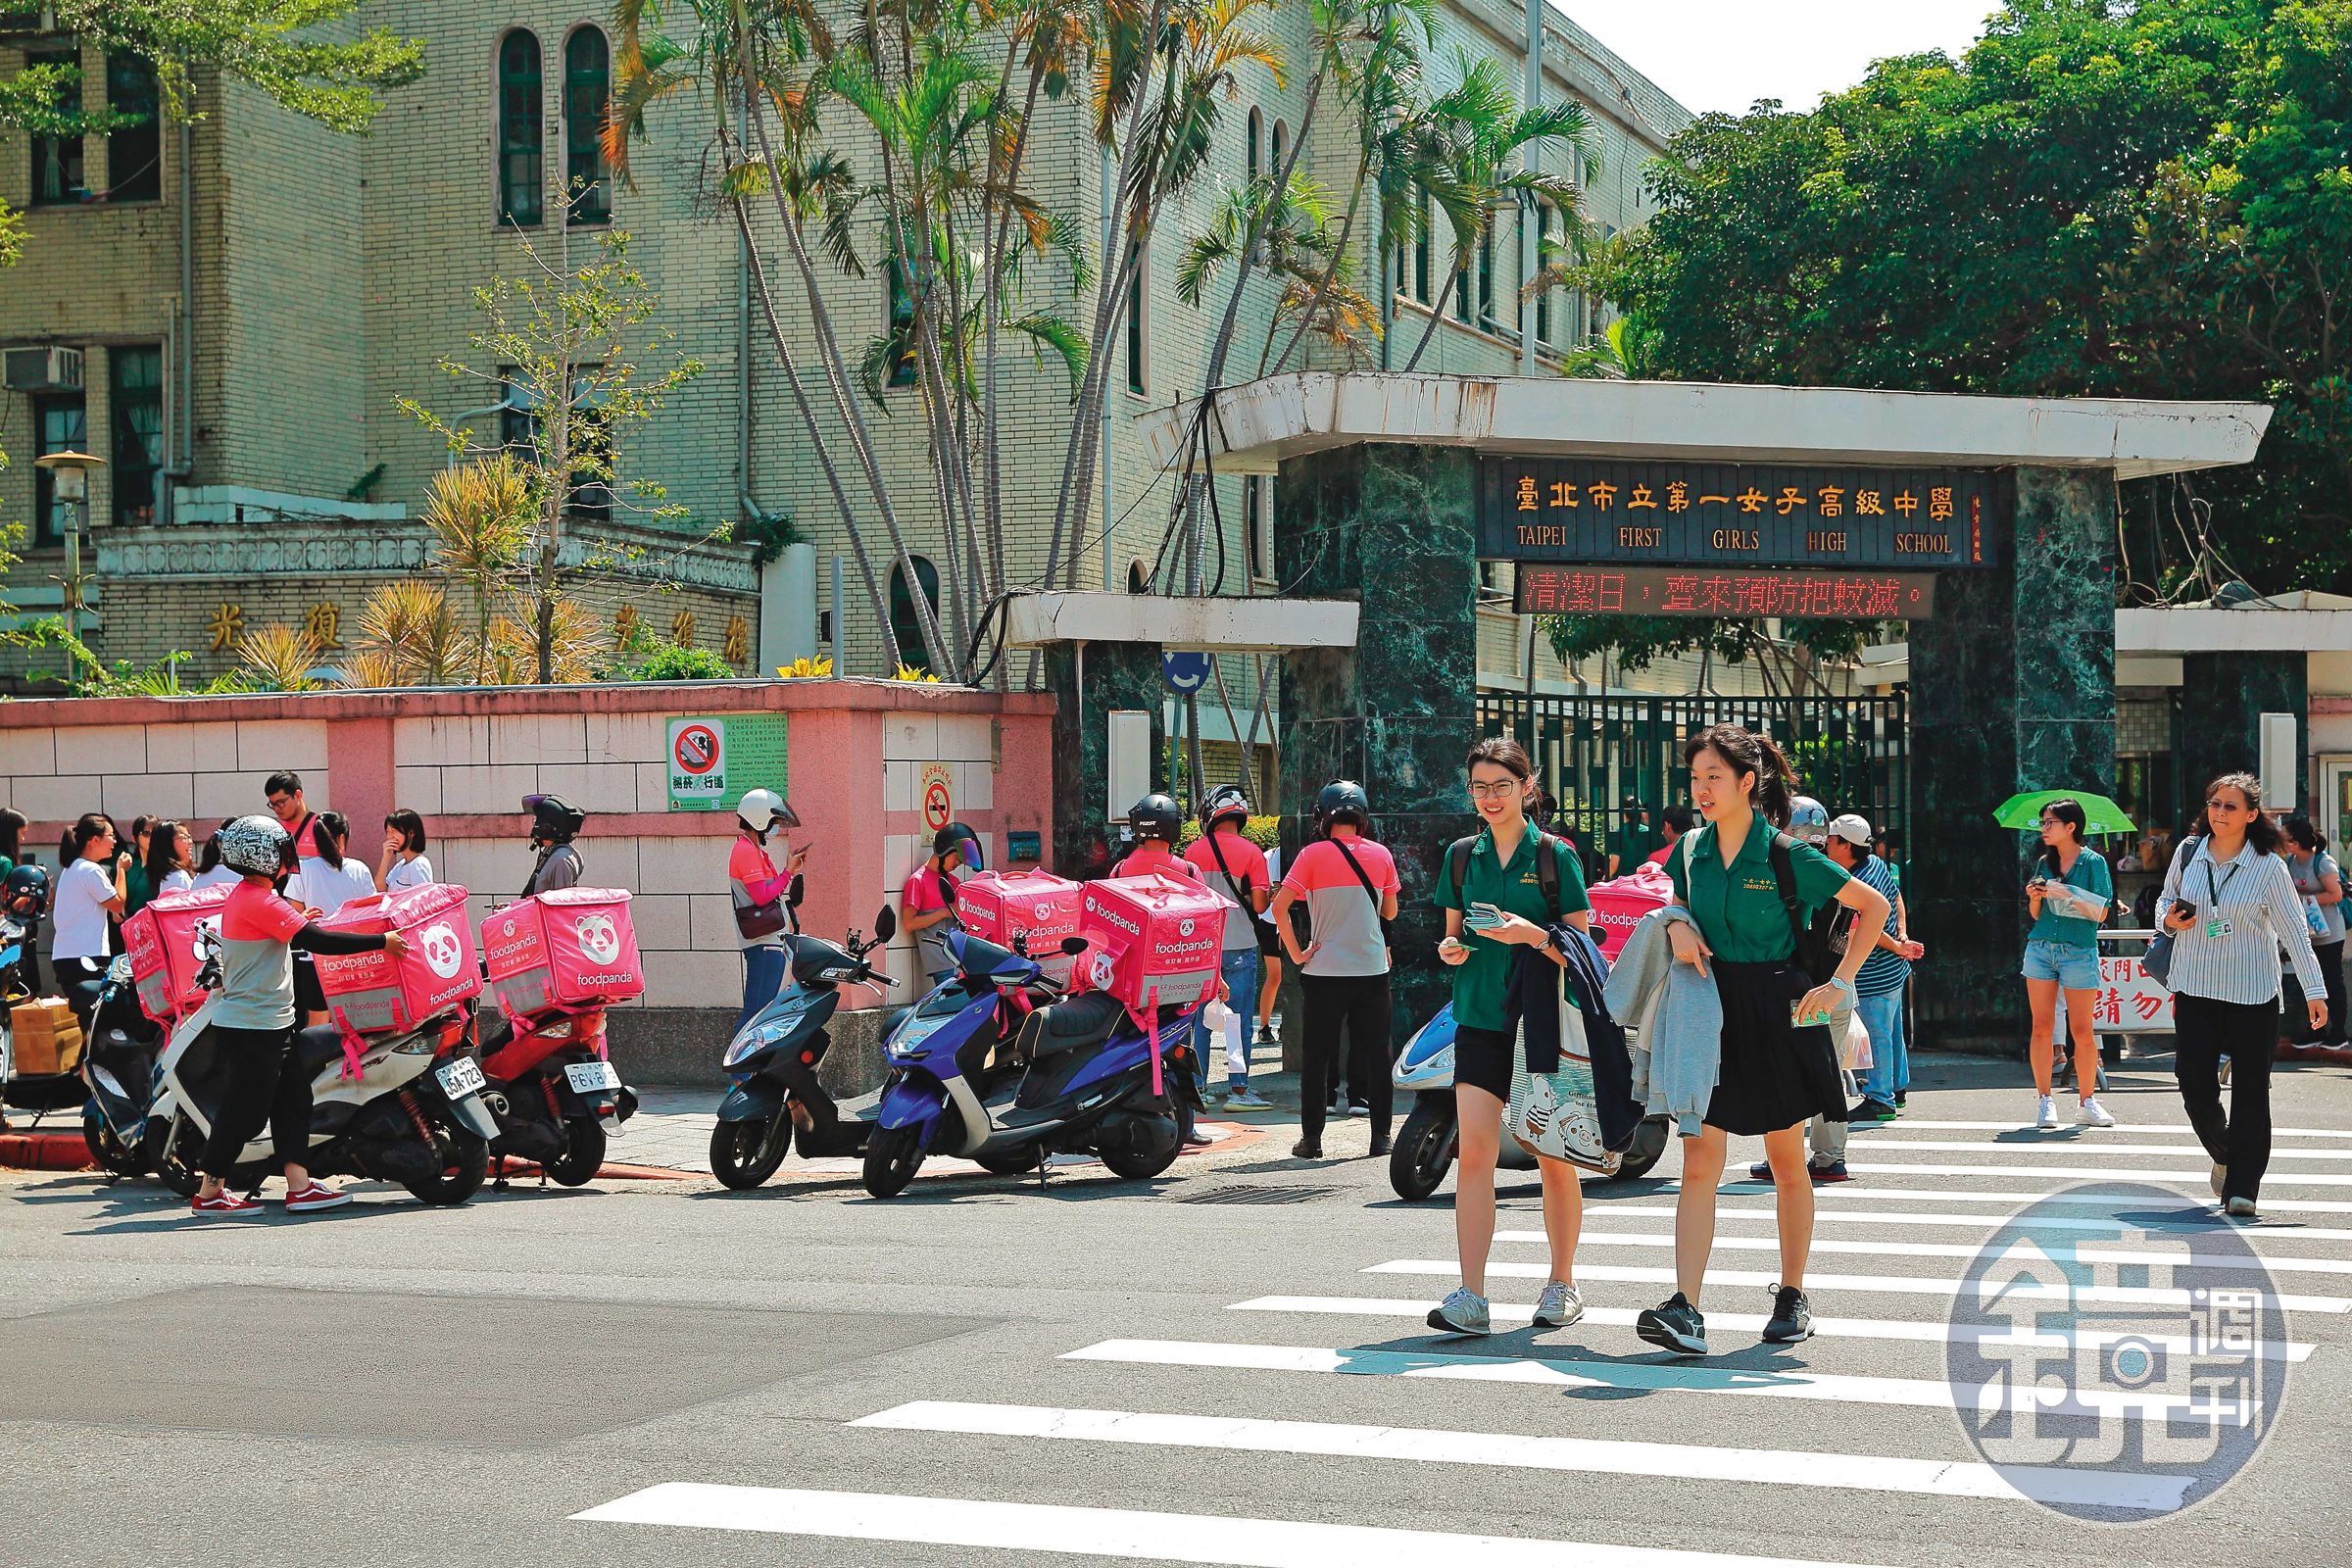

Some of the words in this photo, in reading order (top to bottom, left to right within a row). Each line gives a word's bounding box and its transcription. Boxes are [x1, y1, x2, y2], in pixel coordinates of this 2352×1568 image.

[1516, 475, 1954, 522] 臺北市立第一女子高級中學
[1517, 525, 1567, 546] TAIPEI
[1619, 527, 1662, 547] FIRST
[1713, 529, 1760, 550] GIRLS
[1808, 532, 1847, 552] HIGH
[1896, 533, 1953, 553] SCHOOL
[966, 900, 996, 921] foodpanda
[1097, 904, 1141, 937] foodpanda
[490, 934, 538, 960] foodpanda
[1155, 938, 1214, 955] foodpanda
[323, 951, 385, 972] foodpanda
[429, 976, 474, 1006] foodpanda
[577, 970, 632, 988] foodpanda
[445, 1066, 482, 1096] J5A-723
